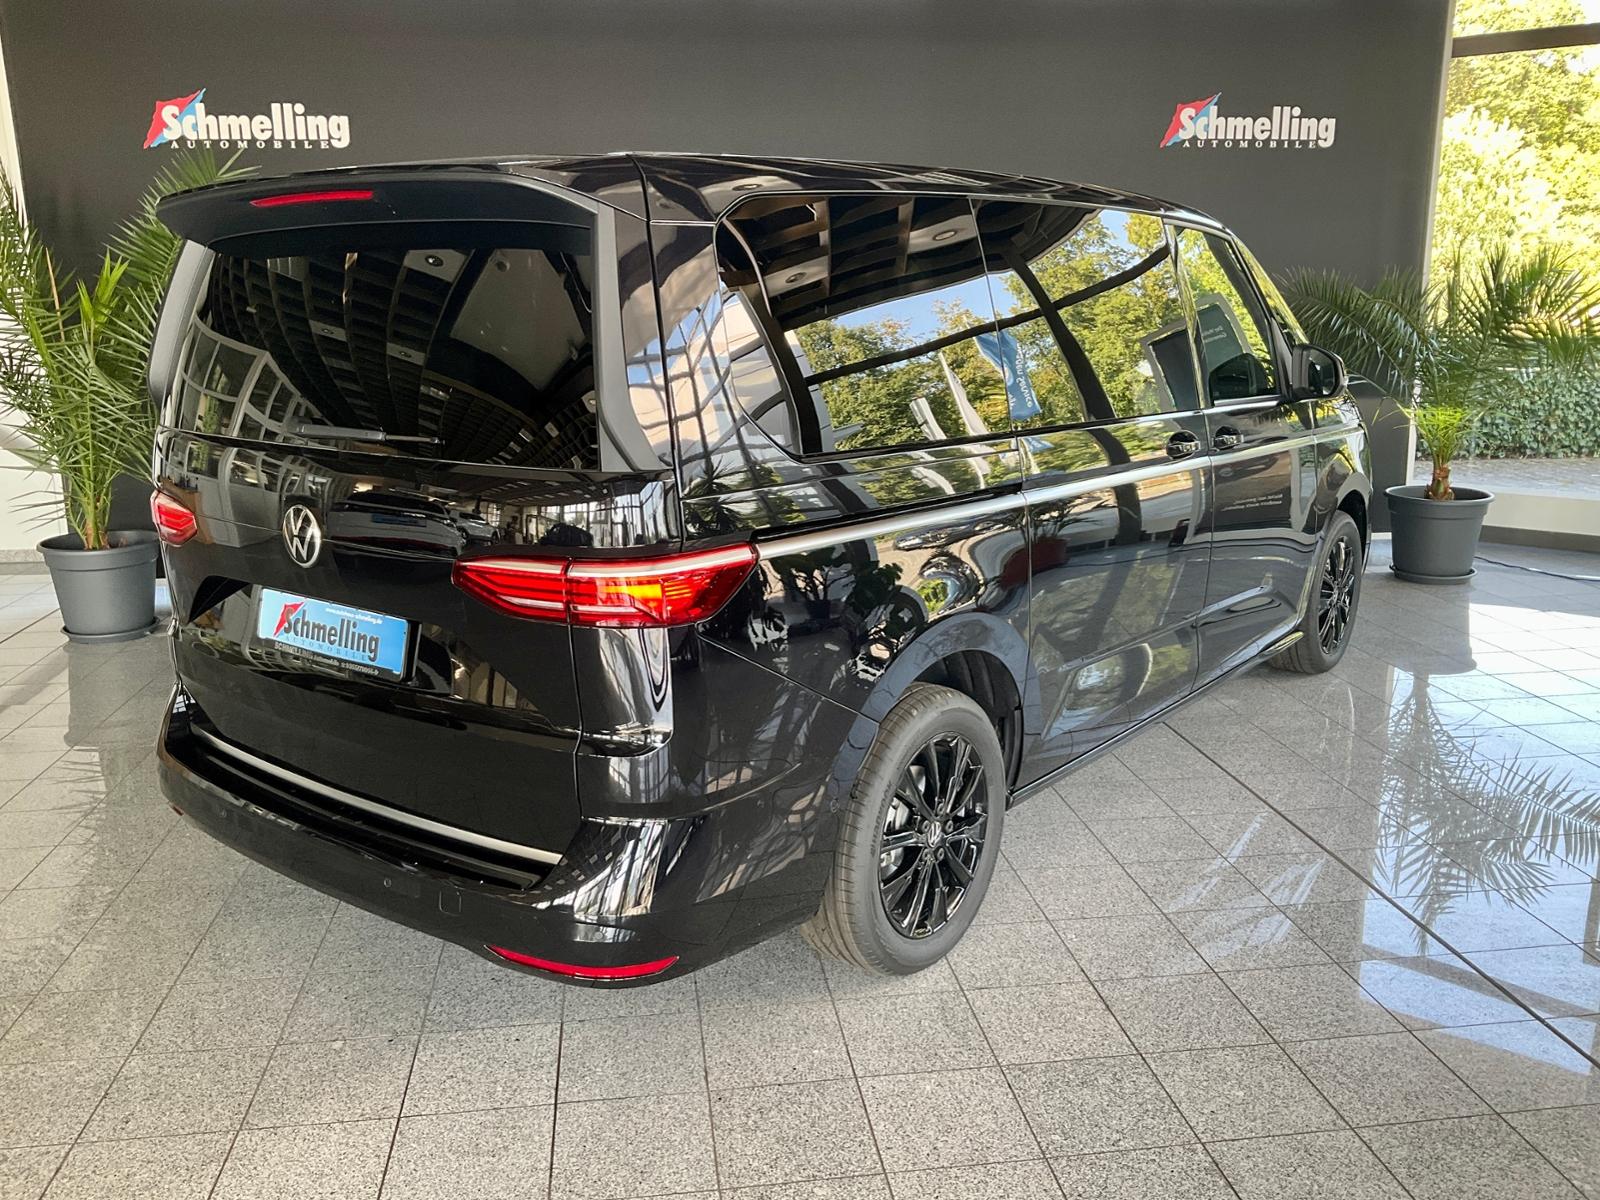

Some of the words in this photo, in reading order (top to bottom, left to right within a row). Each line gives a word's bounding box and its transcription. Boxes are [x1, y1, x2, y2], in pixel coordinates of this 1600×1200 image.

[161, 102, 350, 149] Schmelling
[170, 139, 334, 149] AUTOMOBILE
[1178, 104, 1337, 149] Schmelling
[1182, 139, 1316, 149] AUTOMOBILE
[283, 606, 380, 663] Schmelling
